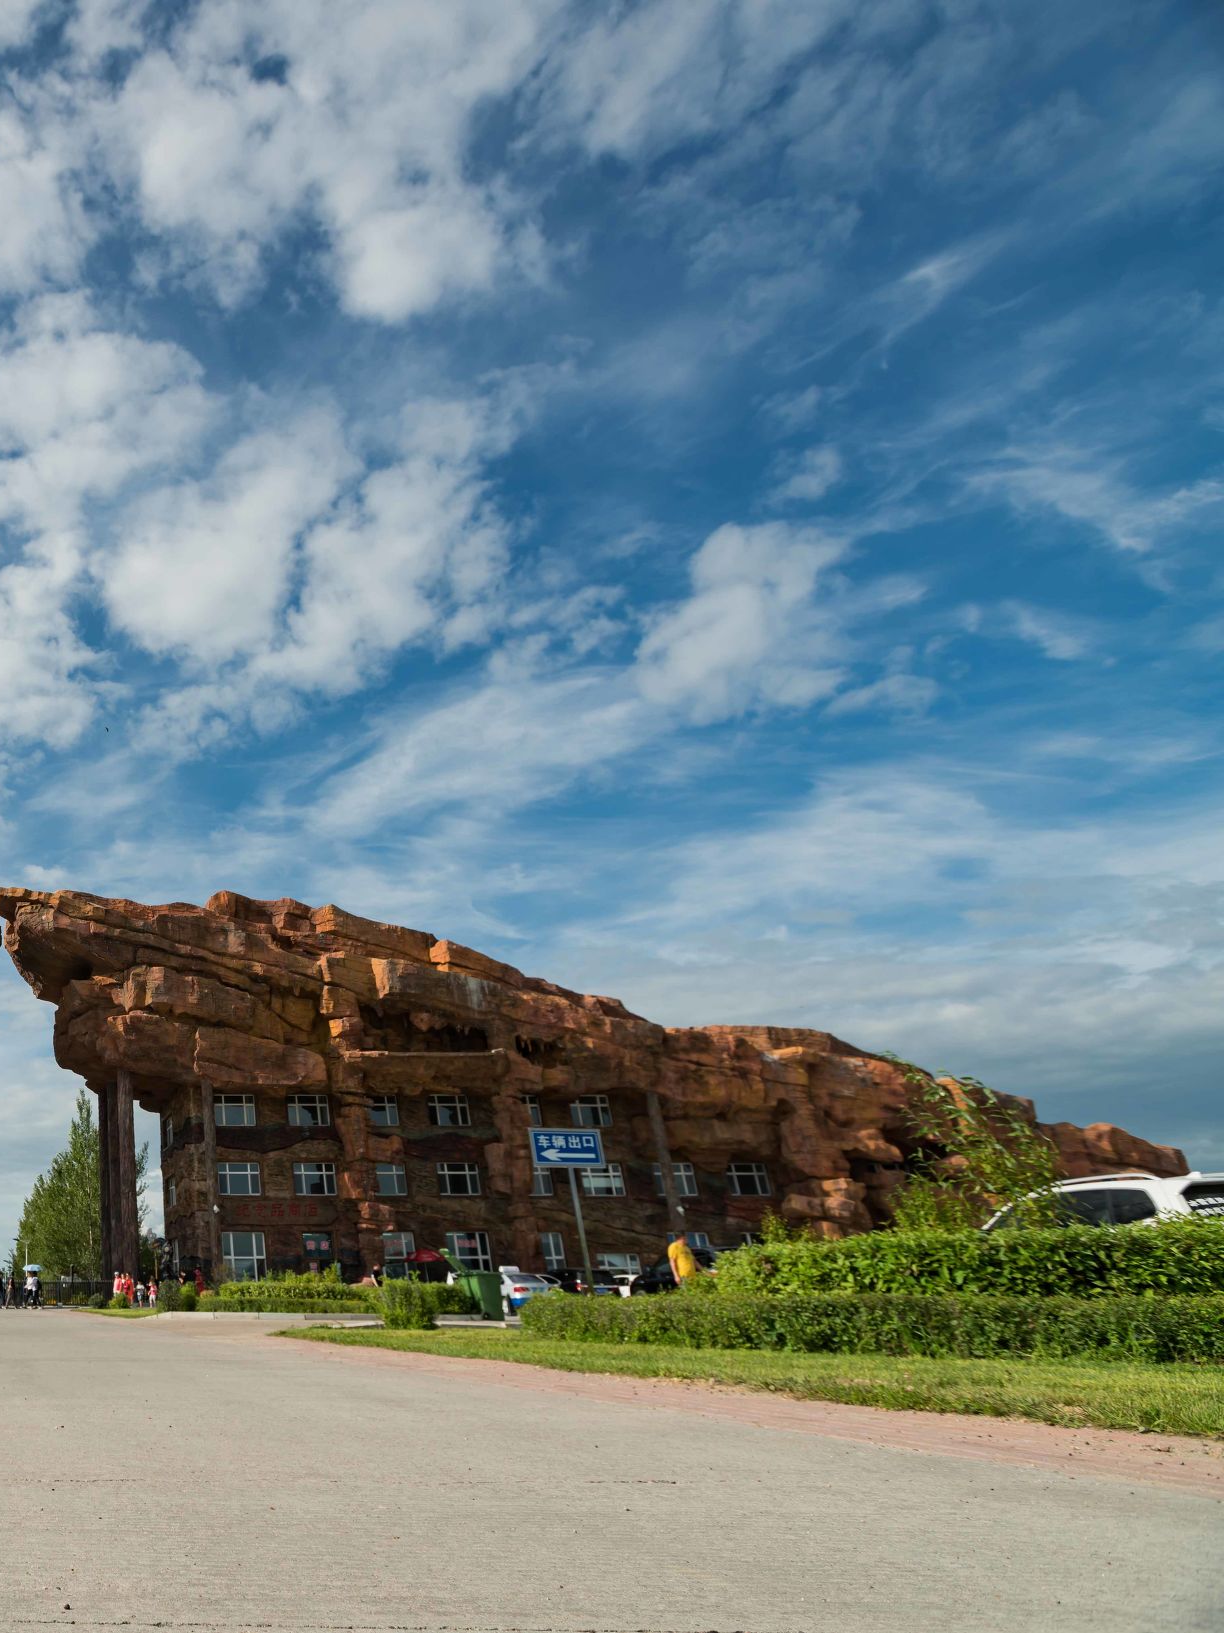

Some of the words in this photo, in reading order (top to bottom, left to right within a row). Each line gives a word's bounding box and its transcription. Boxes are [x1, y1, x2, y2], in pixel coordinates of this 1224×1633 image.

[537, 1135, 595, 1149] 车辆出口
[236, 1201, 318, 1217] 纪念品商店
